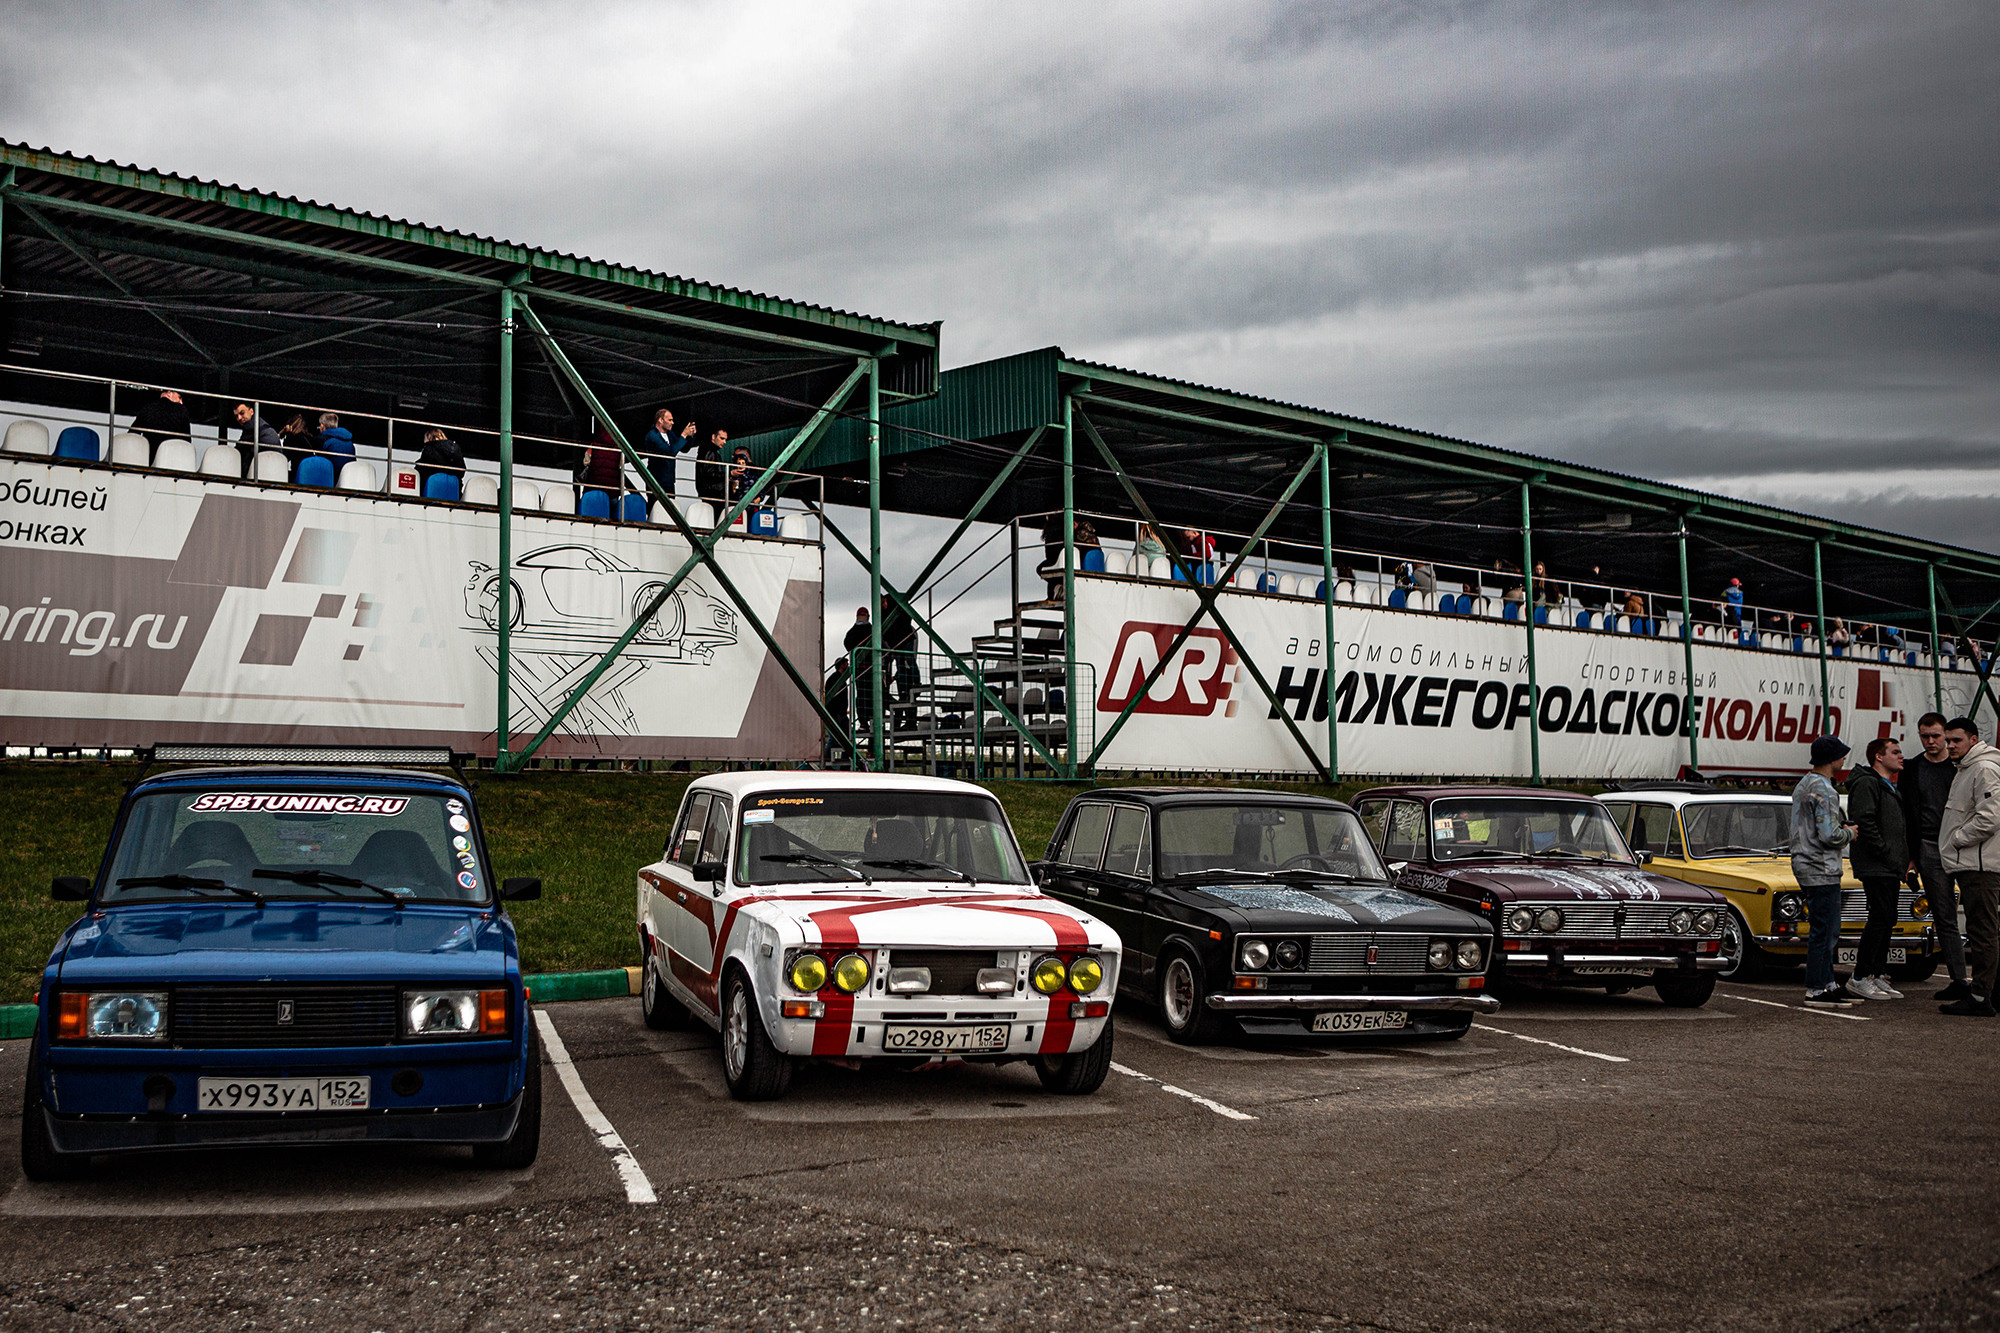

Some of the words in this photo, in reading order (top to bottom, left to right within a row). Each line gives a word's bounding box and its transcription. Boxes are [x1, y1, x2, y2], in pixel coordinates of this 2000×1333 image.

[0, 520, 87, 546] онках
[0, 597, 189, 656] ring.ru
[1108, 630, 1222, 705] NR
[1581, 663, 1717, 688] спортивный
[193, 794, 408, 815] SPBTUNING.RU
[1320, 1013, 1383, 1030] К039ЕК
[1385, 1011, 1402, 1023] 52
[892, 1029, 970, 1048] О298УТ
[975, 1027, 1003, 1041] 152
[208, 1083, 314, 1107] Х993УА
[321, 1081, 361, 1099] 152
[330, 1098, 352, 1106] RUS
